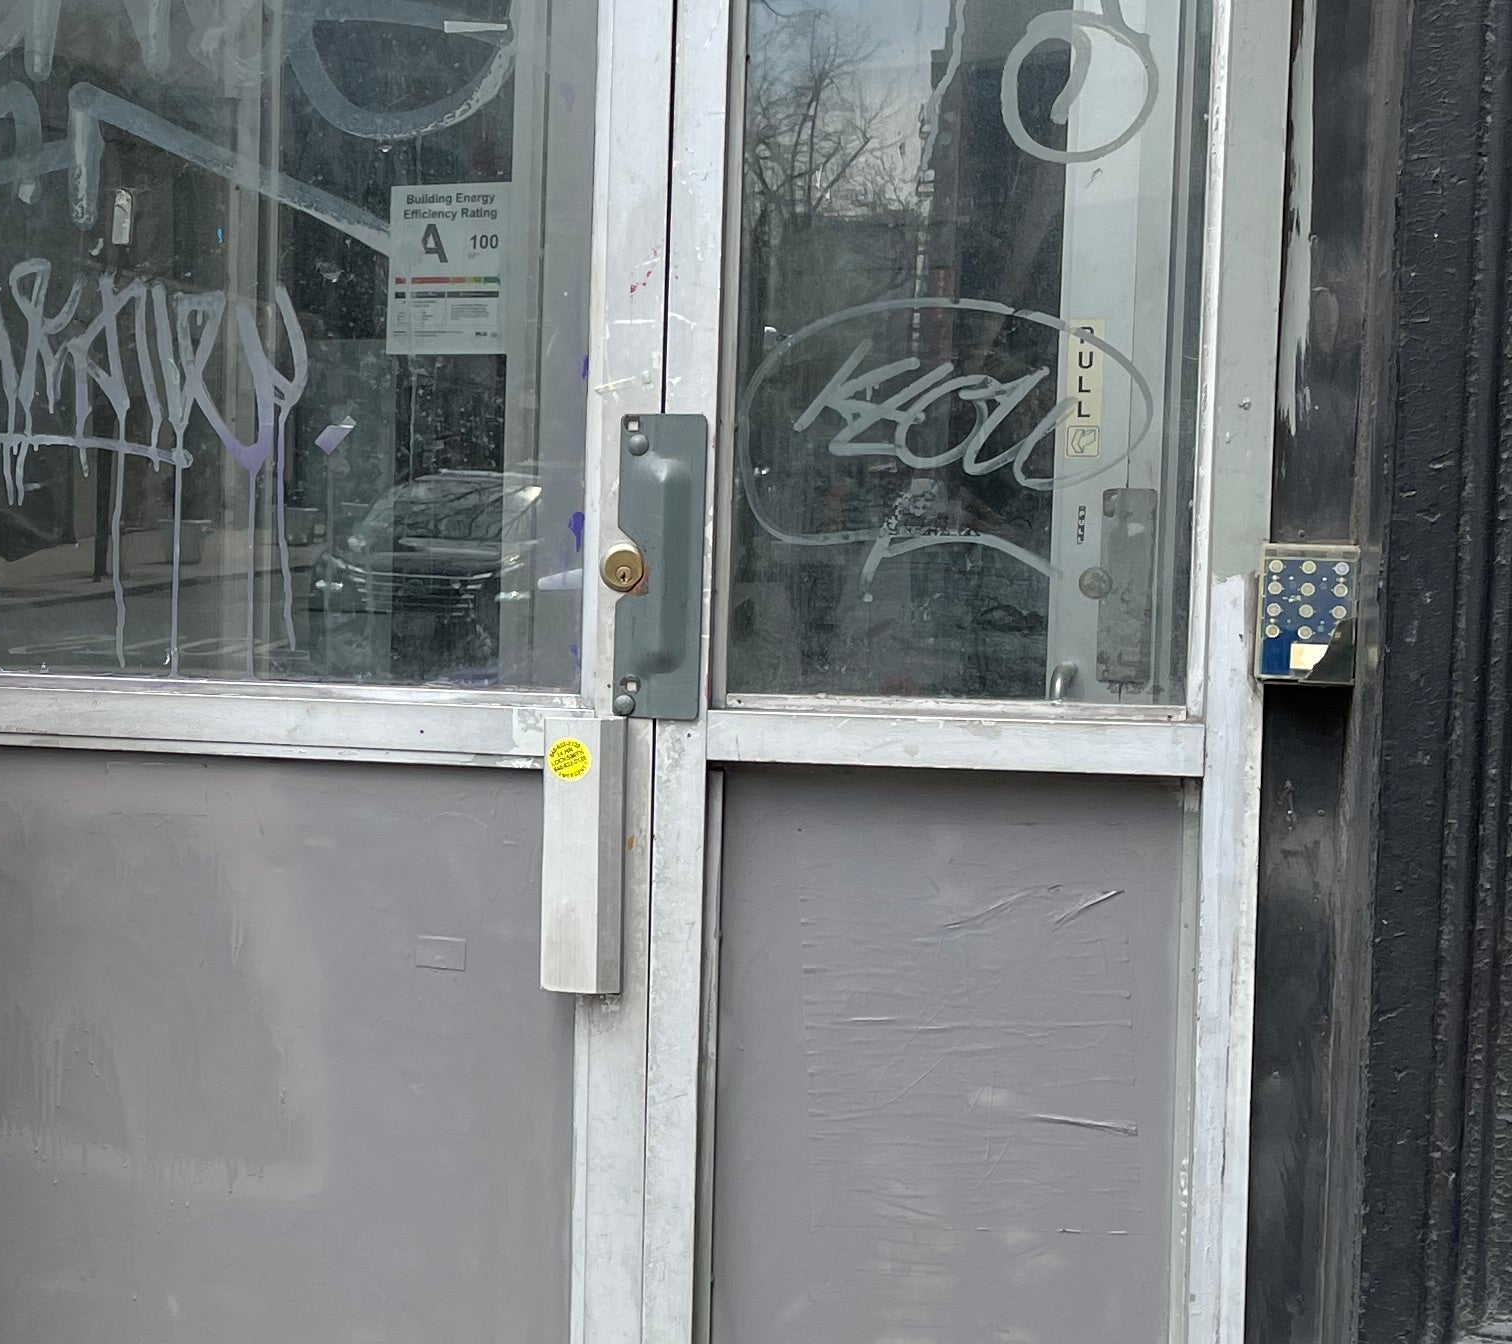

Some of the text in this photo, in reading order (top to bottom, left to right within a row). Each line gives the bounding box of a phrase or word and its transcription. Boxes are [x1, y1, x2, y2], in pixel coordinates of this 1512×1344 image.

[403, 207, 498, 221] Efficiency Rating
[406, 192, 496, 206] Building Energy
[420, 223, 500, 264] A 100
[1077, 326, 1095, 419] PULL
[1076, 509, 1087, 544] PULL
